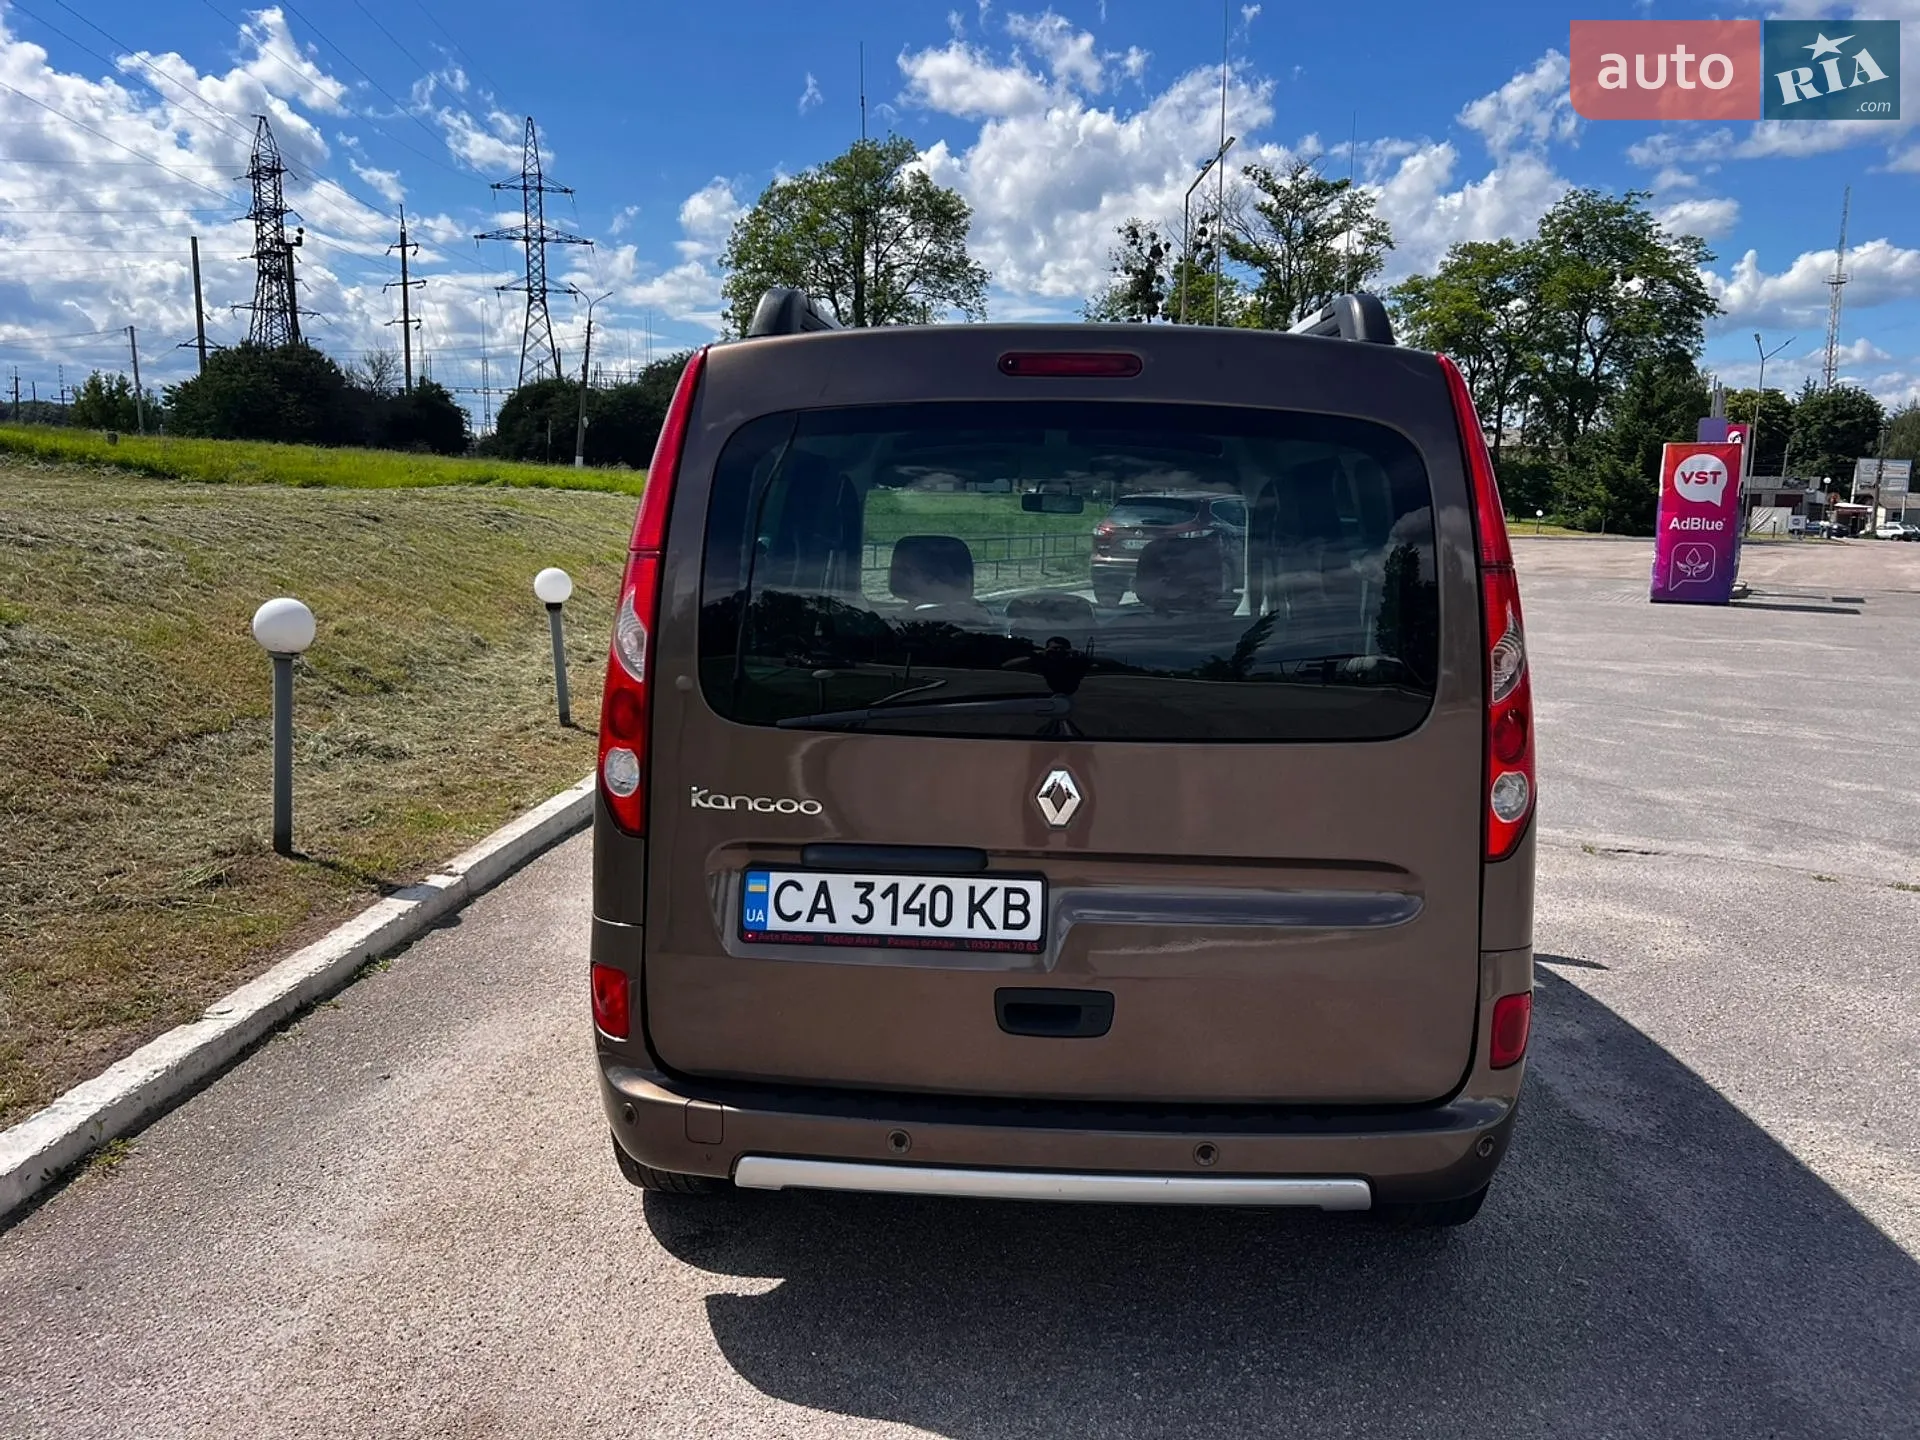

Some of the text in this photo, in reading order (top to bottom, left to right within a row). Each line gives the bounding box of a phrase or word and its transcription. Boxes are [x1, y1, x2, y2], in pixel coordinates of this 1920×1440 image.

[1680, 471, 1722, 485] VST
[1669, 517, 1724, 531] AdBlue
[773, 879, 1032, 931] CA 3140 KB
[746, 908, 765, 923] UA
